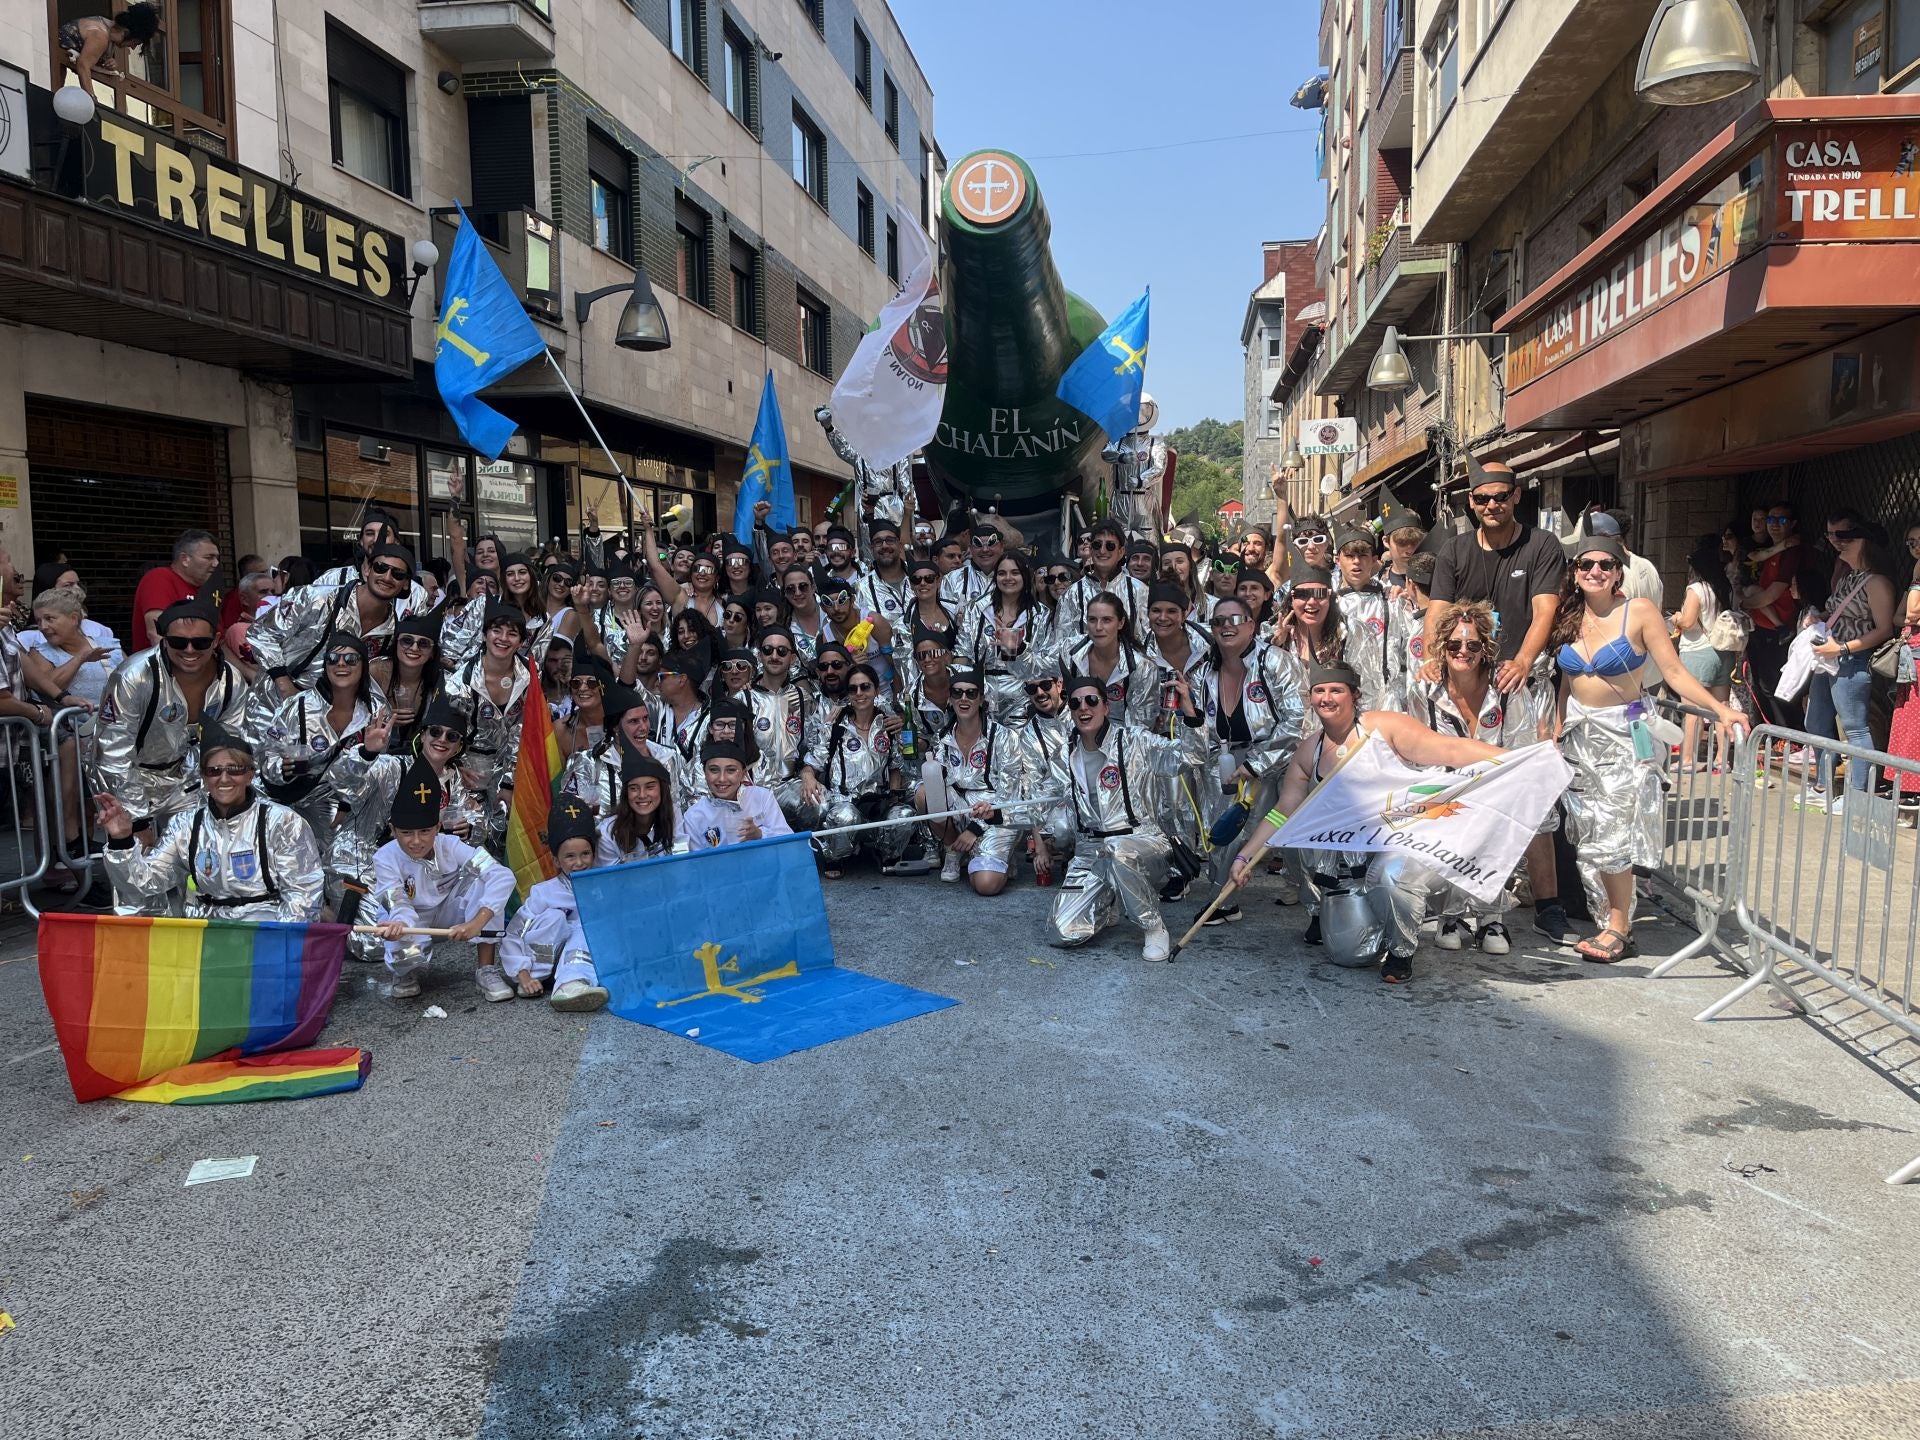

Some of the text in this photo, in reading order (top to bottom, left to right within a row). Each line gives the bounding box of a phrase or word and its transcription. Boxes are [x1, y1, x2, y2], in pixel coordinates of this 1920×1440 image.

[1786, 140, 1861, 168] CASA
[1842, 171, 1861, 180] 1910
[101, 120, 391, 297] TRELLES
[1785, 187, 1920, 222] TRELL
[1544, 208, 1701, 348] CASA TRELLES
[990, 407, 1031, 434] EL
[935, 417, 1081, 458] CHALANÍN
[1304, 443, 1354, 454] BUNKAI
[1309, 825, 1367, 843] uxa'
